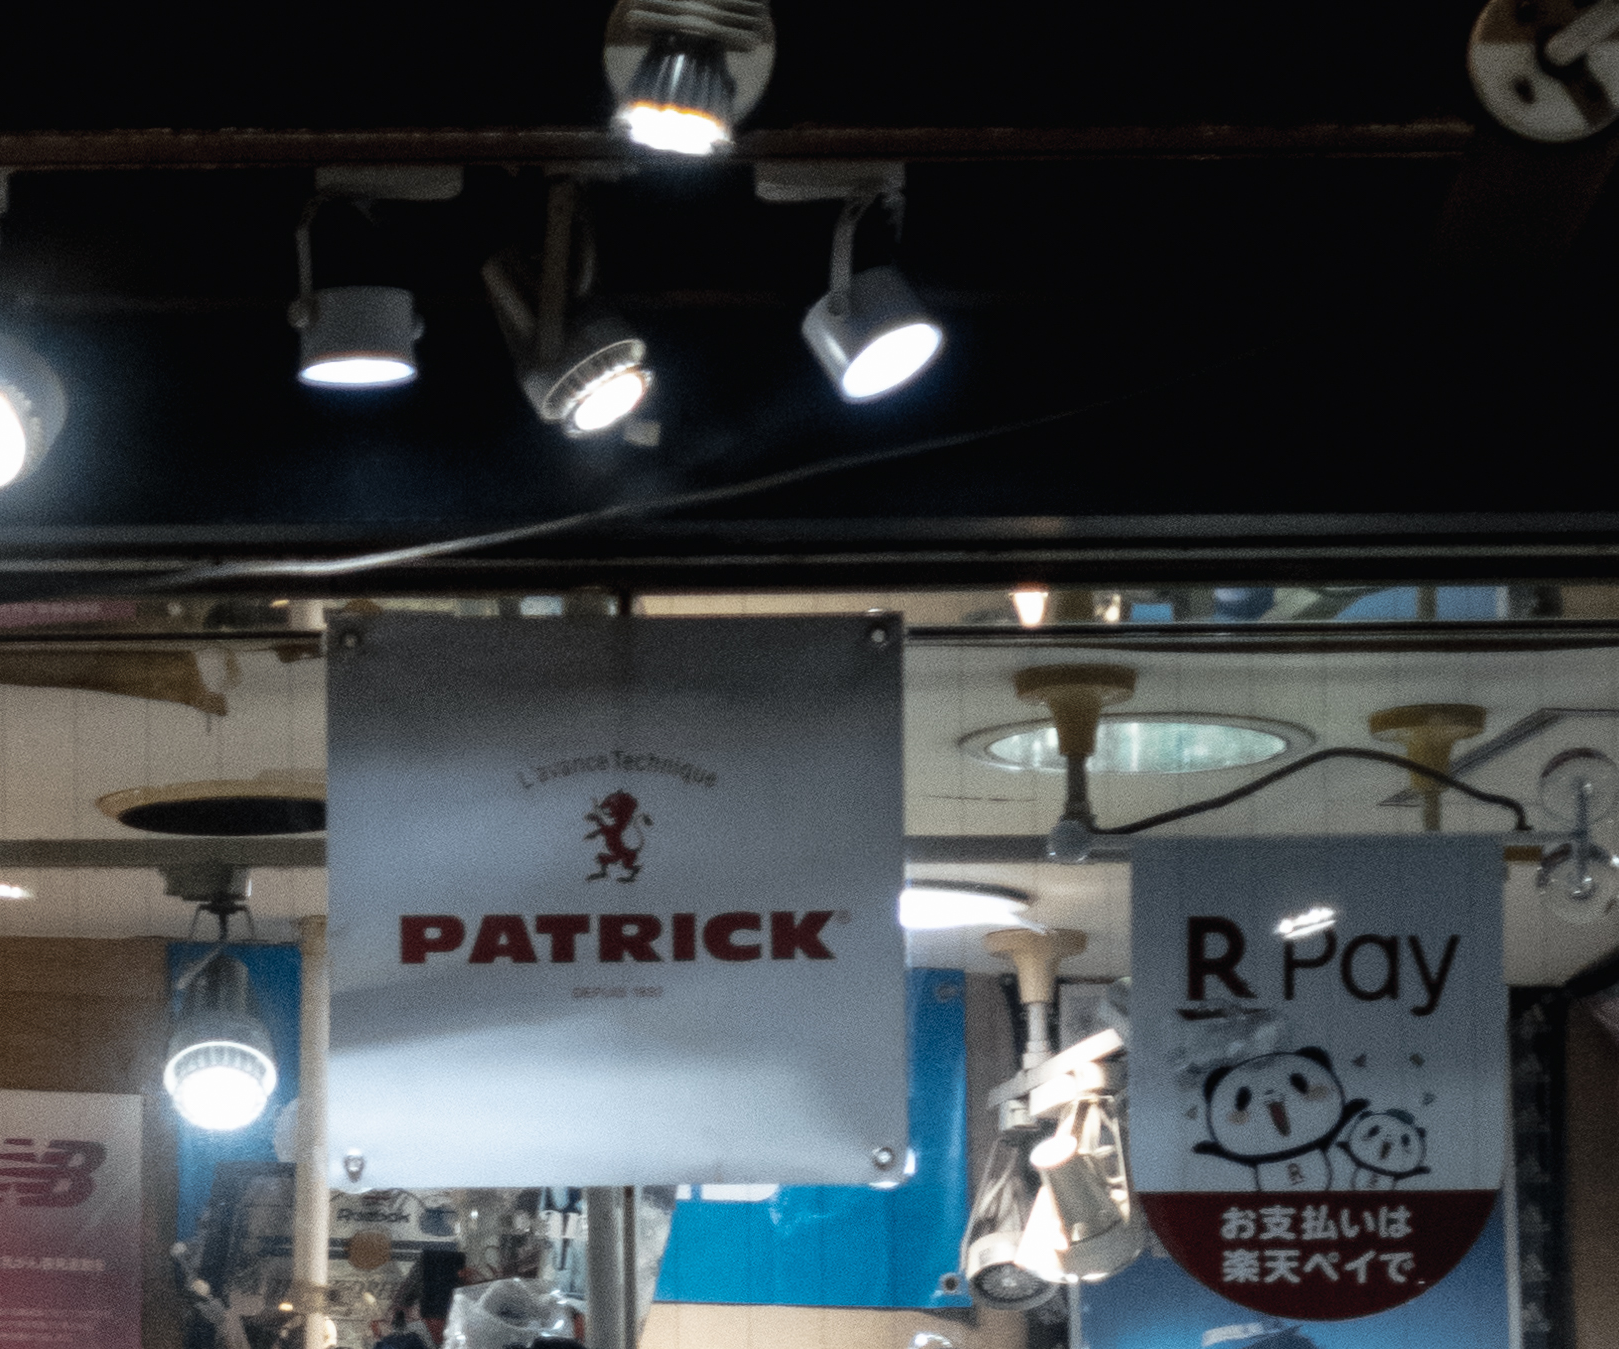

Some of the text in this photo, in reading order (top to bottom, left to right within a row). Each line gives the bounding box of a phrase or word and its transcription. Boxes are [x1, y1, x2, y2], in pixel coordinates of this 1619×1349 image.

[400, 910, 836, 964] PATRICK
[1285, 930, 1460, 1016] Pay
[1220, 1204, 1413, 1243] お支払いは
[1222, 1249, 1416, 1286] 楽天ペイで
